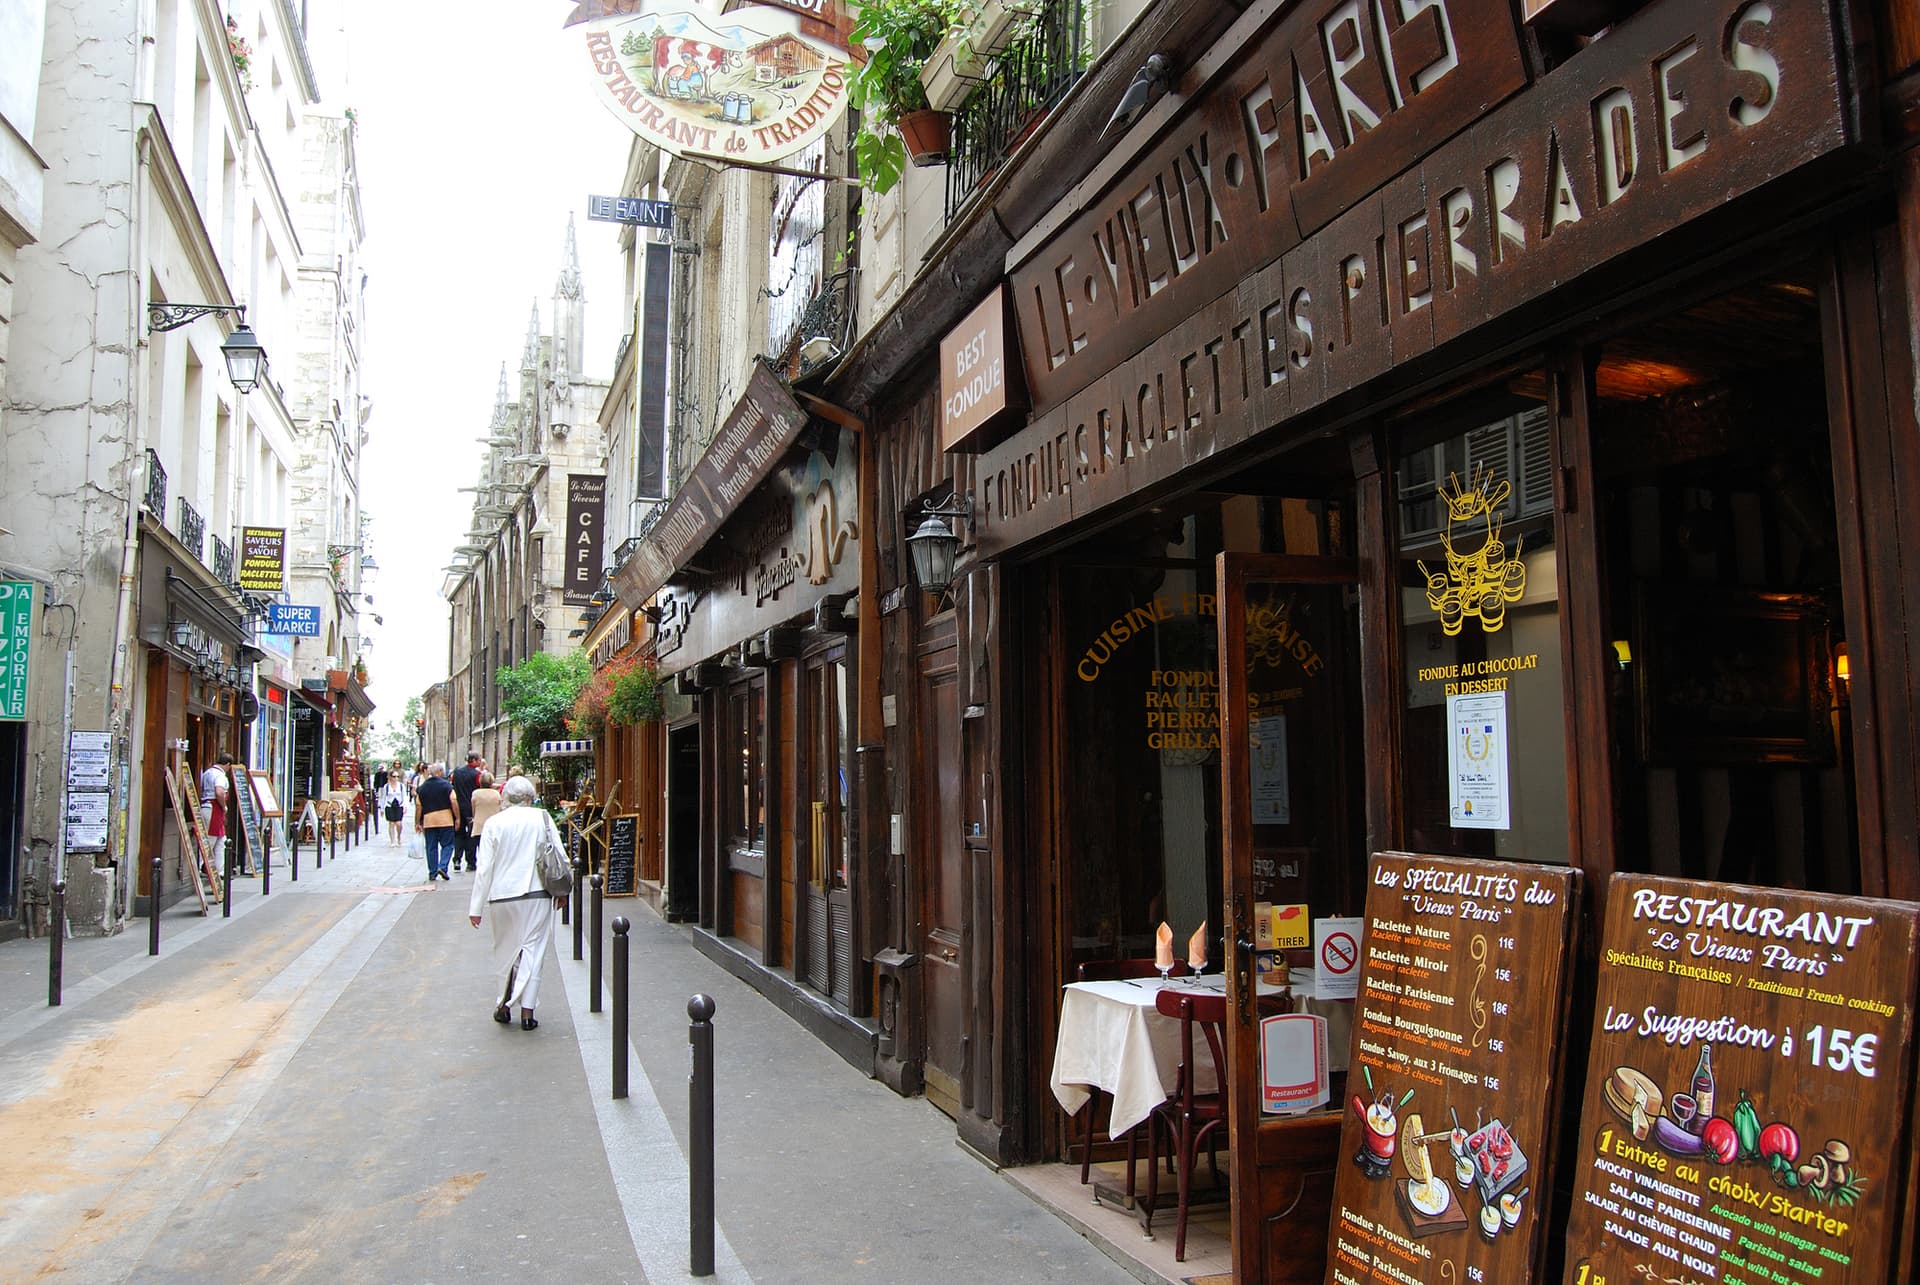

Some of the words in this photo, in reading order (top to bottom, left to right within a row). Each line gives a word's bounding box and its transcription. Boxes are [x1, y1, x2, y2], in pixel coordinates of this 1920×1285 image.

[586, 30, 717, 151] RESTAURANT
[724, 130, 748, 153] de
[752, 56, 846, 150] TRADITION
[1339, 1, 1780, 346] PIERRADES
[590, 196, 610, 218] LE
[615, 198, 669, 224] SAINT
[1035, 254, 1089, 371] LE
[1093, 133, 1229, 320] VIEUX
[956, 328, 986, 379] BEST
[945, 357, 1001, 425] FONDUE
[707, 398, 763, 474] Reblochonnade
[245, 536, 281, 545] SAVEURS
[247, 548, 278, 556] SAVOIE
[577, 512, 592, 581] CAFE
[241, 570, 283, 579] RACLETTES
[244, 560, 281, 568] FONDUES
[241, 580, 282, 589] PIERRADES
[564, 589, 592, 600] Brasser
[271, 621, 317, 634] MARKET
[277, 608, 312, 620] SUPER
[1077, 598, 1176, 683] CUISINE
[11, 612, 29, 714] EMPORTER
[1151, 670, 1220, 687] FONDU
[1418, 664, 1459, 681] FONDUE
[1461, 662, 1475, 676] AU
[1477, 654, 1537, 674] CHOCOLAT
[1146, 690, 1259, 709] RACLETS
[1445, 682, 1458, 696] EN
[1461, 676, 1508, 694] DESSERT
[1147, 711, 1260, 729] PIERRAS
[1147, 732, 1261, 749] GRILLAS
[1375, 866, 1400, 888] Les
[1403, 866, 1519, 901] SPÉCIALITÉS
[1524, 881, 1555, 905] du
[1373, 918, 1411, 934] Raclette
[1415, 925, 1450, 940] Nature
[1499, 937, 1514, 950] 11€
[1633, 889, 1873, 947] RESTAURANT
[1276, 937, 1305, 947] TIRER
[1371, 930, 1401, 943] Raclette
[1404, 936, 1421, 946] with
[1423, 940, 1452, 951] cheese
[1685, 932, 1752, 962] Vieux
[1368, 960, 1395, 971] Mirror
[1397, 966, 1430, 979] raclette
[1369, 947, 1410, 965] Raclette
[1414, 956, 1448, 972] Miroir
[1495, 968, 1511, 982] 15€
[1366, 976, 1402, 993] Raclette
[1405, 985, 1454, 1006] Parisienne
[1492, 1002, 1508, 1015] 18€
[1606, 949, 1663, 972] Spécialités
[1667, 959, 1732, 984] Françaises
[1747, 977, 1803, 998] Traditional
[1806, 988, 1844, 1005] French
[1847, 997, 1896, 1017] cooking
[1399, 997, 1432, 1011] raclette
[1363, 1007, 1392, 1024] Fondue
[1395, 1016, 1463, 1043] Bourguignonne
[1488, 1038, 1504, 1052] 15€
[1402, 1030, 1428, 1045] fondue
[1431, 1040, 1448, 1051] with
[1450, 1045, 1472, 1057] meat
[1604, 1006, 1634, 1031] La
[1638, 1006, 1775, 1049] Suggestion
[1781, 1027, 1793, 1057] à
[1805, 1024, 1878, 1077] 15€
[1358, 1053, 1384, 1068] Fondue
[1386, 1062, 1402, 1073] with
[1404, 1066, 1410, 1075] 3
[1412, 1070, 1444, 1086] cheeses
[1360, 1039, 1385, 1056] Fondue
[1413, 1059, 1428, 1069] aux
[1430, 1060, 1436, 1071] 3
[1438, 1063, 1478, 1085] Fromages
[1484, 1076, 1499, 1090] 15€
[1600, 1129, 1613, 1154] 1
[1615, 1139, 1668, 1173] Entrée
[1675, 1164, 1700, 1185] au
[1594, 1158, 1633, 1180] AVOCAT
[1634, 1171, 1700, 1207] VINAIGRETTE
[1710, 1203, 1751, 1227] Avocado
[1754, 1219, 1776, 1237] with
[1778, 1229, 1817, 1253] vinegar
[1819, 1246, 1851, 1265] sauce
[1340, 1219, 1384, 1247] Provençale
[1387, 1241, 1419, 1264] fondue
[1341, 1206, 1374, 1231] Fondue
[1377, 1223, 1432, 1260] Provençale
[1584, 1191, 1619, 1215] SALADE
[1621, 1207, 1636, 1220] AU
[1637, 1213, 1677, 1241] CHÈVRE
[1678, 1230, 1716, 1254] CHAUD
[1720, 1249, 1745, 1267] Salad
[1747, 1262, 1770, 1278] with
[1771, 1271, 1789, 1285] hot
[1609, 1182, 1655, 1209] SALADE
[1657, 1202, 1732, 1241] PARISIENNE
[1738, 1236, 1785, 1263] Parisian
[1788, 1258, 1823, 1278] salad
[1336, 1249, 1369, 1273] Parisian
[1467, 1266, 1484, 1283] 15€
[1338, 1237, 1370, 1263] Fondue
[1604, 1220, 1649, 1248] SALADE
[1653, 1240, 1680, 1262] AUX
[1682, 1253, 1716, 1278] NOIX
[1723, 1273, 1747, 1285] Sala
[1334, 1268, 1361, 1285] Fondu
